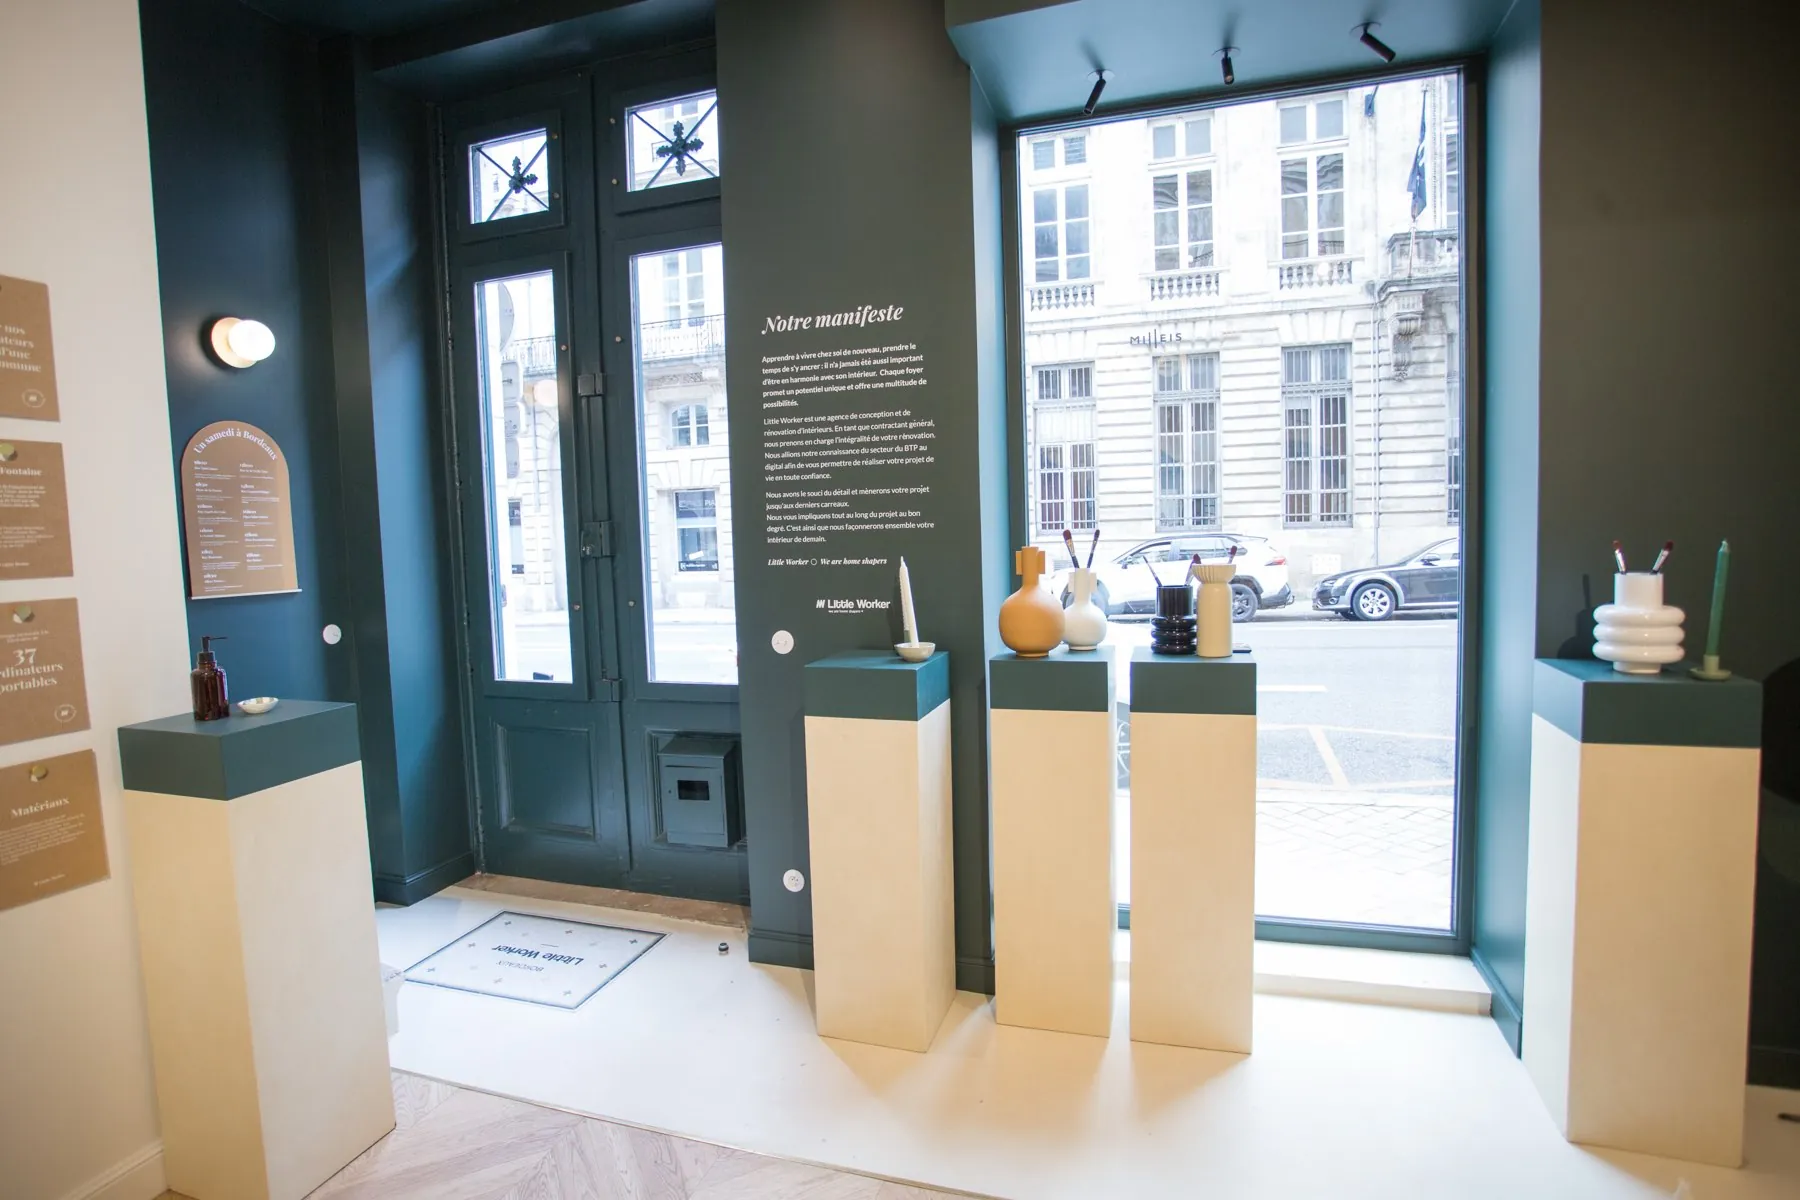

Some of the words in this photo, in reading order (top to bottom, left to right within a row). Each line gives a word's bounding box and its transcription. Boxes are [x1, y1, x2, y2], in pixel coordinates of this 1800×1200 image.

[761, 316, 812, 335] Notre
[816, 305, 903, 328] manifeste
[762, 354, 795, 363] Apprendre
[882, 344, 909, 353] prendre
[839, 360, 860, 369] jamais
[861, 357, 871, 366] été
[873, 357, 889, 365] aussi
[890, 355, 923, 364] important
[790, 375, 819, 383] harmonie
[763, 389, 785, 398] promet
[795, 386, 823, 395] potentiel
[885, 379, 917, 387] multitude
[859, 411, 894, 419] conception
[871, 422, 908, 430] contractant
[193, 442, 206, 454] Un
[205, 428, 234, 444] samedi
[236, 428, 242, 437] à
[243, 431, 278, 461] Bordeaux
[765, 463, 783, 471] digital
[910, 485, 929, 494] projet
[878, 511, 898, 519] projet
[862, 557, 887, 565] shapers
[828, 599, 854, 609] Little
[856, 599, 891, 609] Worker
[13, 648, 37, 667] 37
[0, 664, 64, 679] dinateurs
[11, 797, 70, 817] Matériaux
[491, 945, 541, 959] Worker
[542, 953, 584, 965] Little
